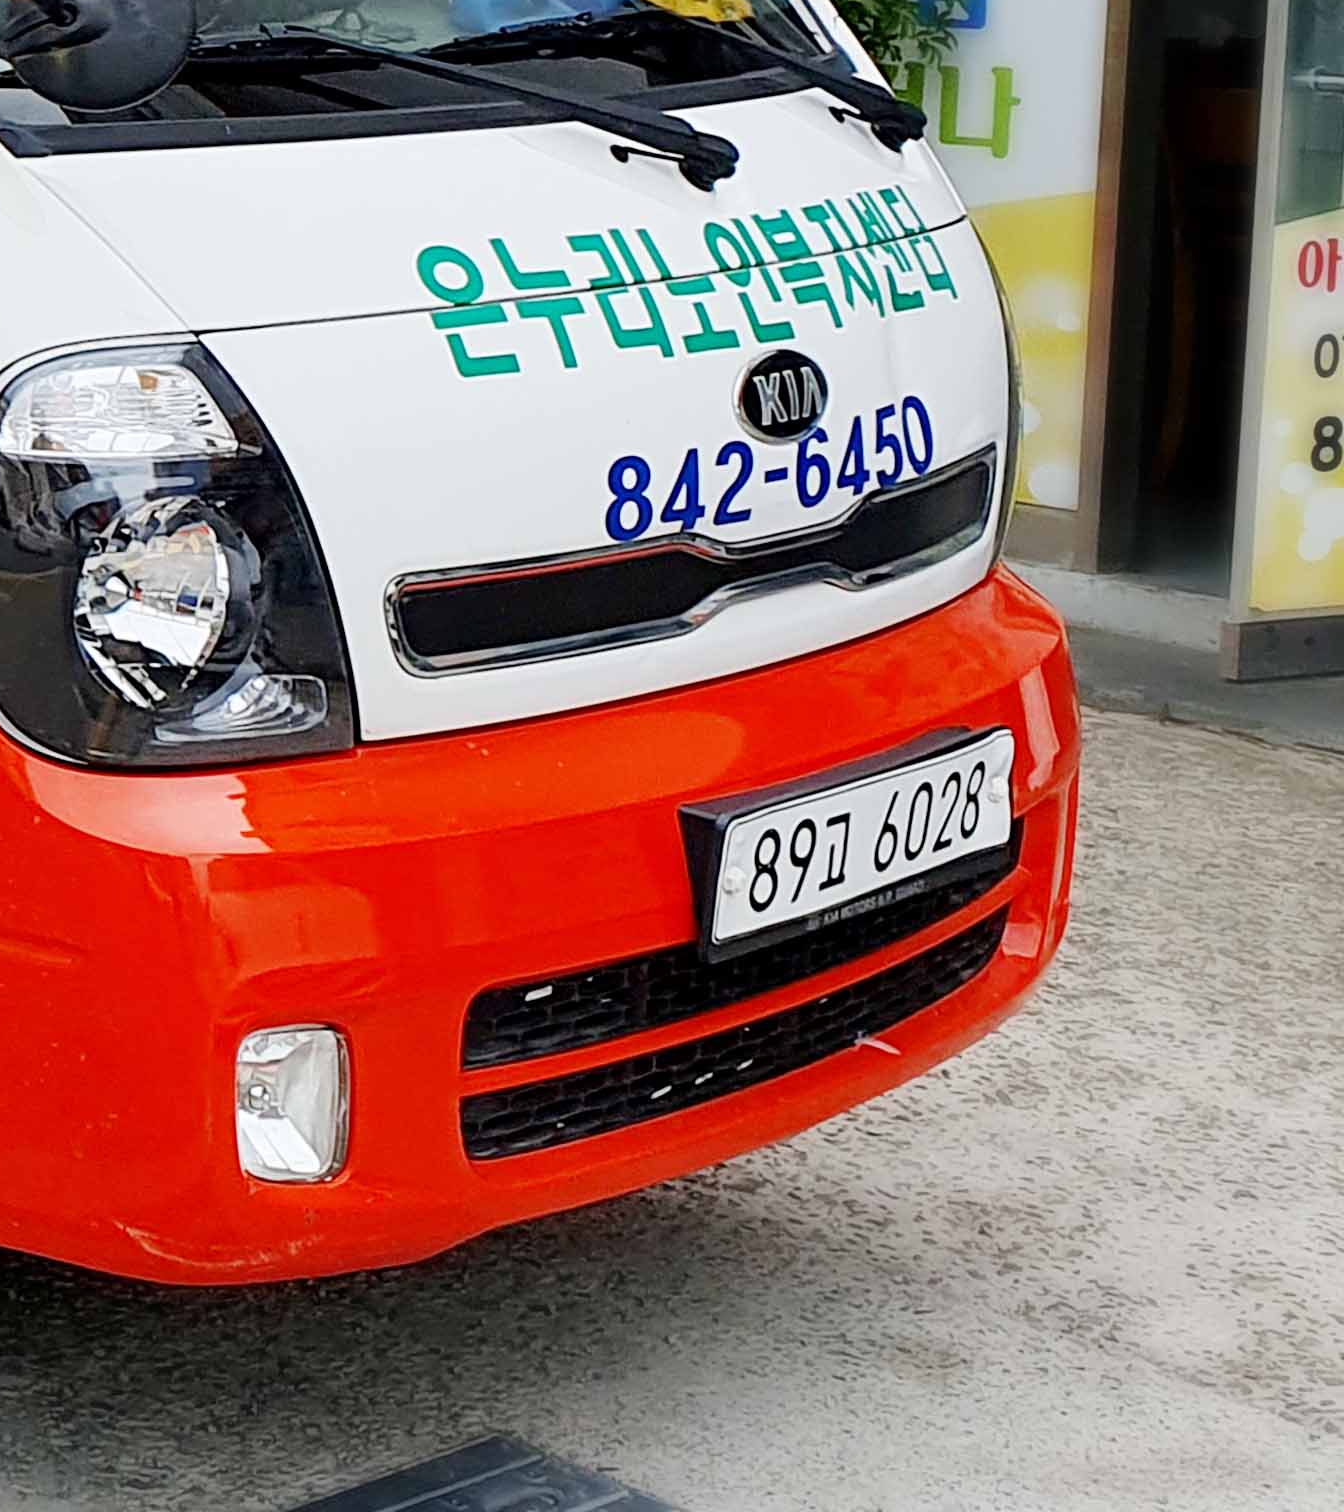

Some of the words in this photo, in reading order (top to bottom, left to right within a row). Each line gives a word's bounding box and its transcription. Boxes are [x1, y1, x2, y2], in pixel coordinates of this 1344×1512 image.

[416, 184, 960, 377] 온누리노인복지센터
[604, 395, 935, 542] 842-6450
[752, 364, 824, 427] KIA
[748, 812, 852, 913] 89고
[873, 760, 986, 873] 6028
